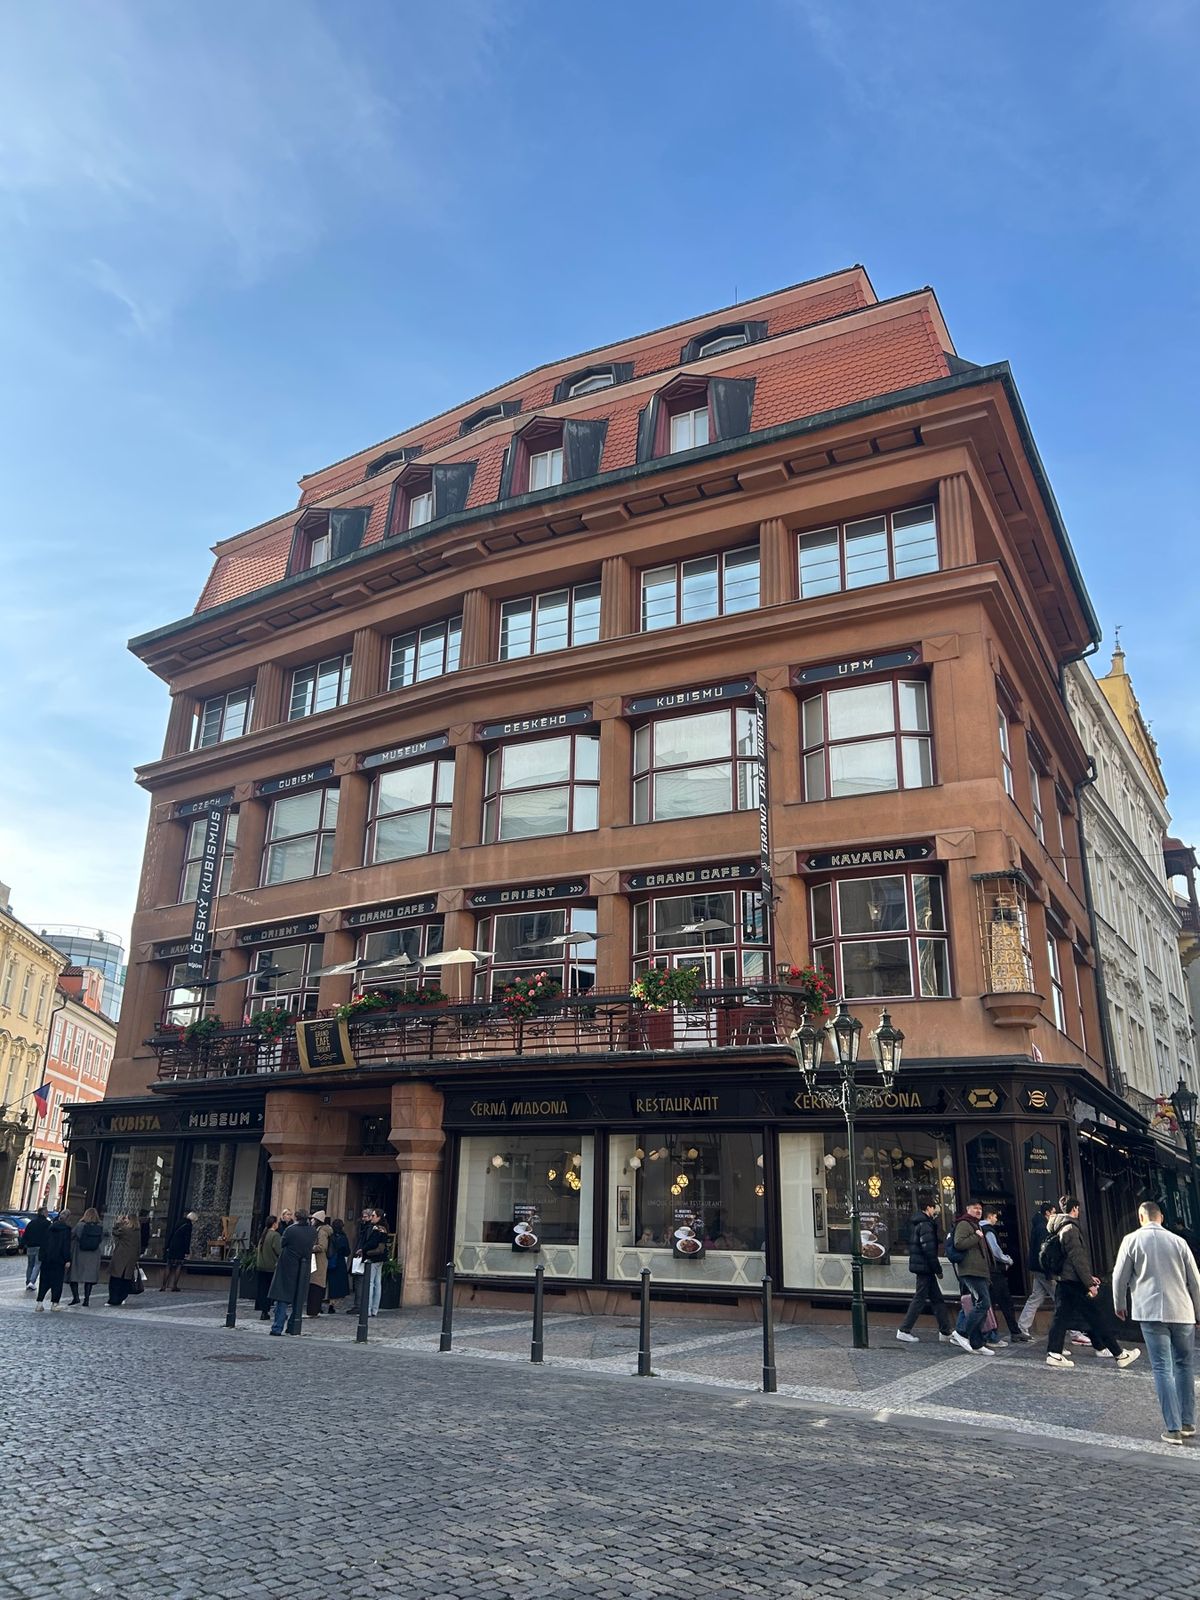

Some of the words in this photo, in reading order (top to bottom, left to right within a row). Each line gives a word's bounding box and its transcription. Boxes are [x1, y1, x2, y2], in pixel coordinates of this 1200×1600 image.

[838, 659, 874, 675] UPM
[656, 687, 723, 707] KUBISMU
[756, 708, 765, 759] ORIENT
[382, 742, 427, 761] MUSEUM
[278, 773, 315, 789] CUBISM
[192, 798, 221, 811] CZECH
[759, 803, 768, 855] GRAND
[190, 899, 209, 954] ČESKÝ
[201, 811, 221, 893] KUBISMUS
[646, 870, 695, 886] GRAND
[701, 866, 740, 880] CAFE
[500, 886, 555, 901] ORIENT
[359, 908, 394, 923] GRAND
[260, 925, 299, 940] ORIENT
[470, 1099, 507, 1116] ČERNÁ
[510, 1101, 568, 1116] MADONA
[636, 1096, 719, 1112] RESTAURANT
[110, 1115, 161, 1132] KUBISTA
[189, 1112, 250, 1127] MUSEUM
